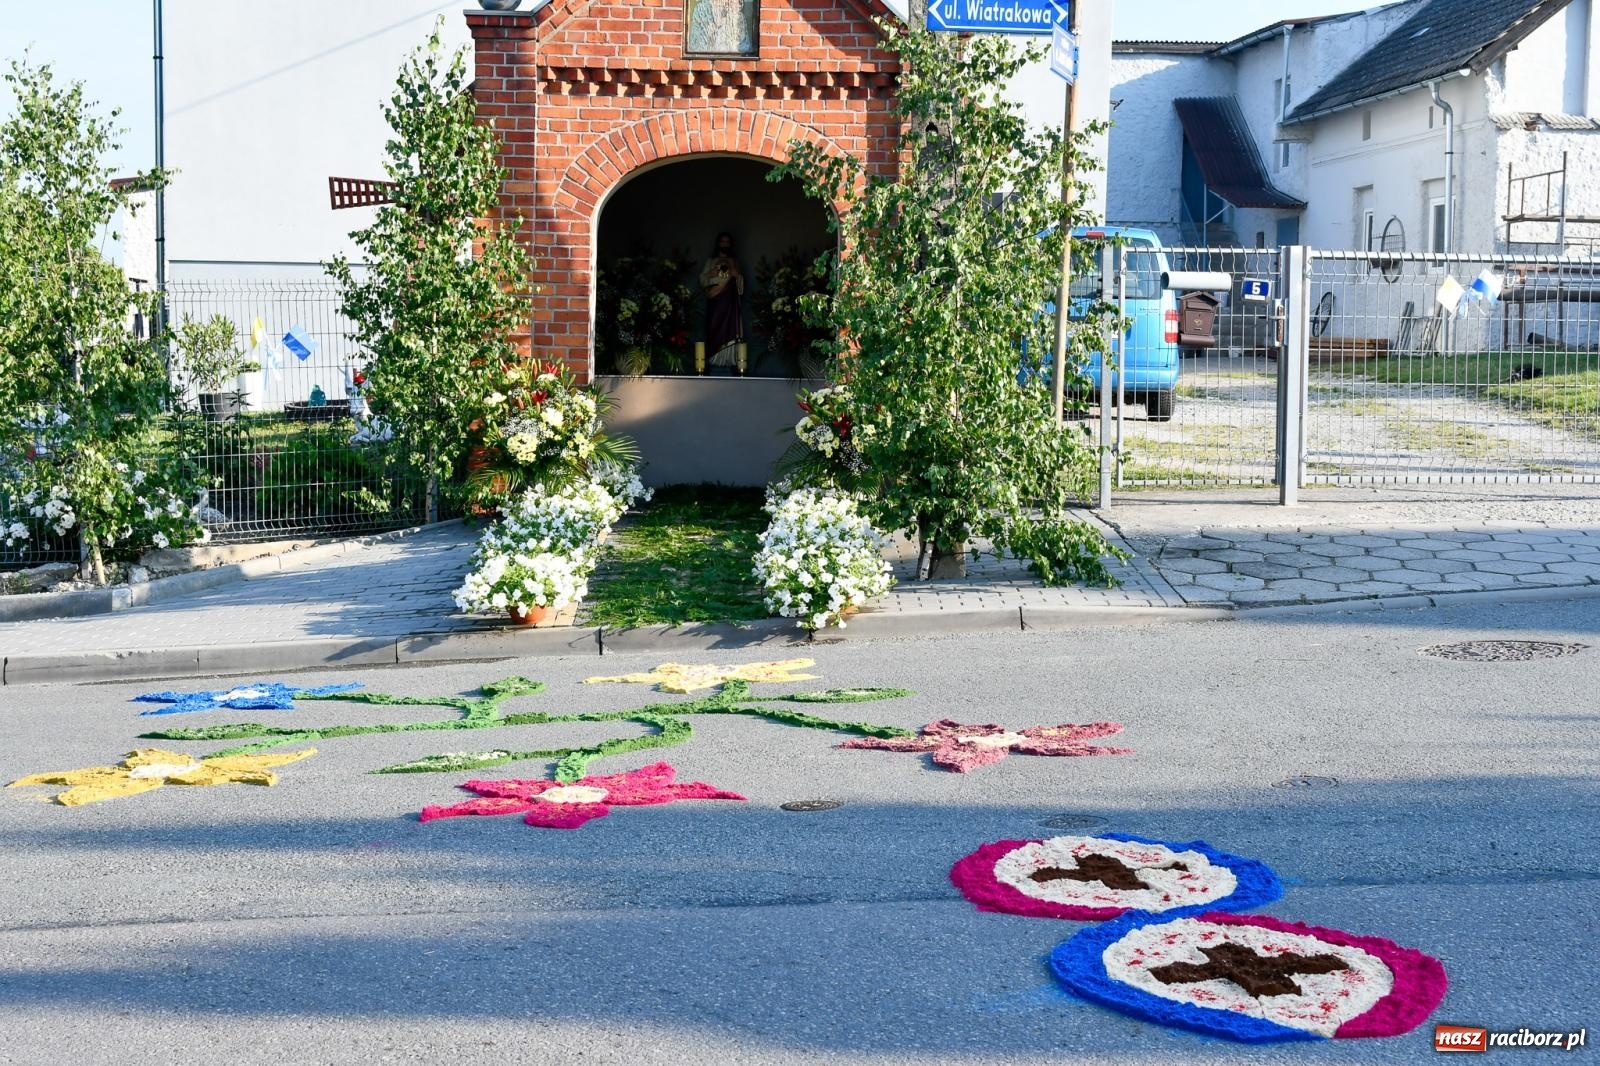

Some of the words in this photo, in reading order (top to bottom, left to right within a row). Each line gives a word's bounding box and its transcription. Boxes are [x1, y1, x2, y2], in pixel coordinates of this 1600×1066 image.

[944, 0, 961, 19] ul.
[966, 0, 1052, 24] Wiatrakowa
[1251, 281, 1261, 295] 5
